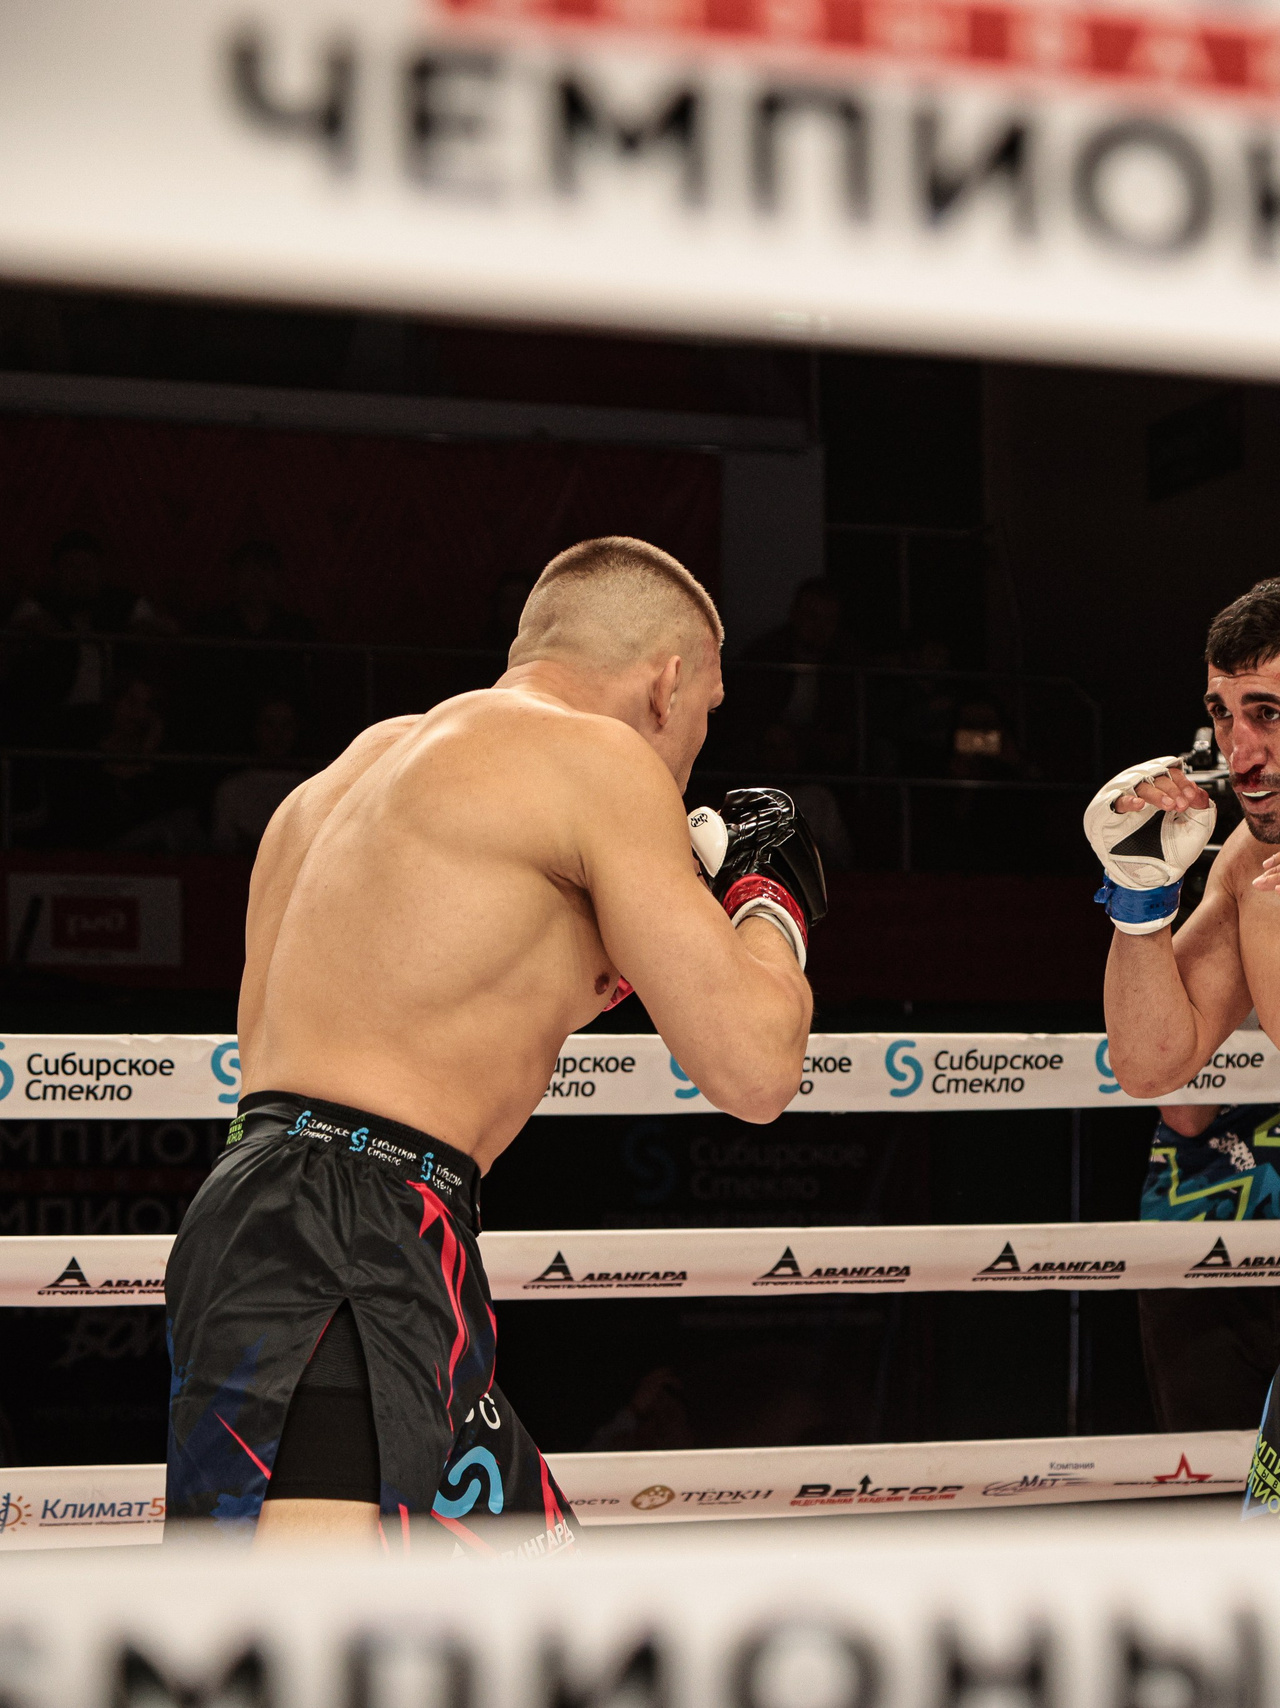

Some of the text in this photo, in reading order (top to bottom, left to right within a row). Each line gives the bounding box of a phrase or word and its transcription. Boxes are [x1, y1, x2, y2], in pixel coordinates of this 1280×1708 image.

[27, 1052, 175, 1081] Сибирское
[934, 1049, 1064, 1074] Сибирское
[25, 1079, 133, 1101] Стекло
[932, 1073, 1025, 1094] Стекло
[581, 1270, 688, 1282] АВАНГАРД
[808, 1265, 912, 1277] АВАНГАРД
[1027, 1260, 1127, 1272] АВАНГАРД
[1050, 1461, 1095, 1470] Компания
[0, 1605, 1268, 1708] МПИОНЫ
